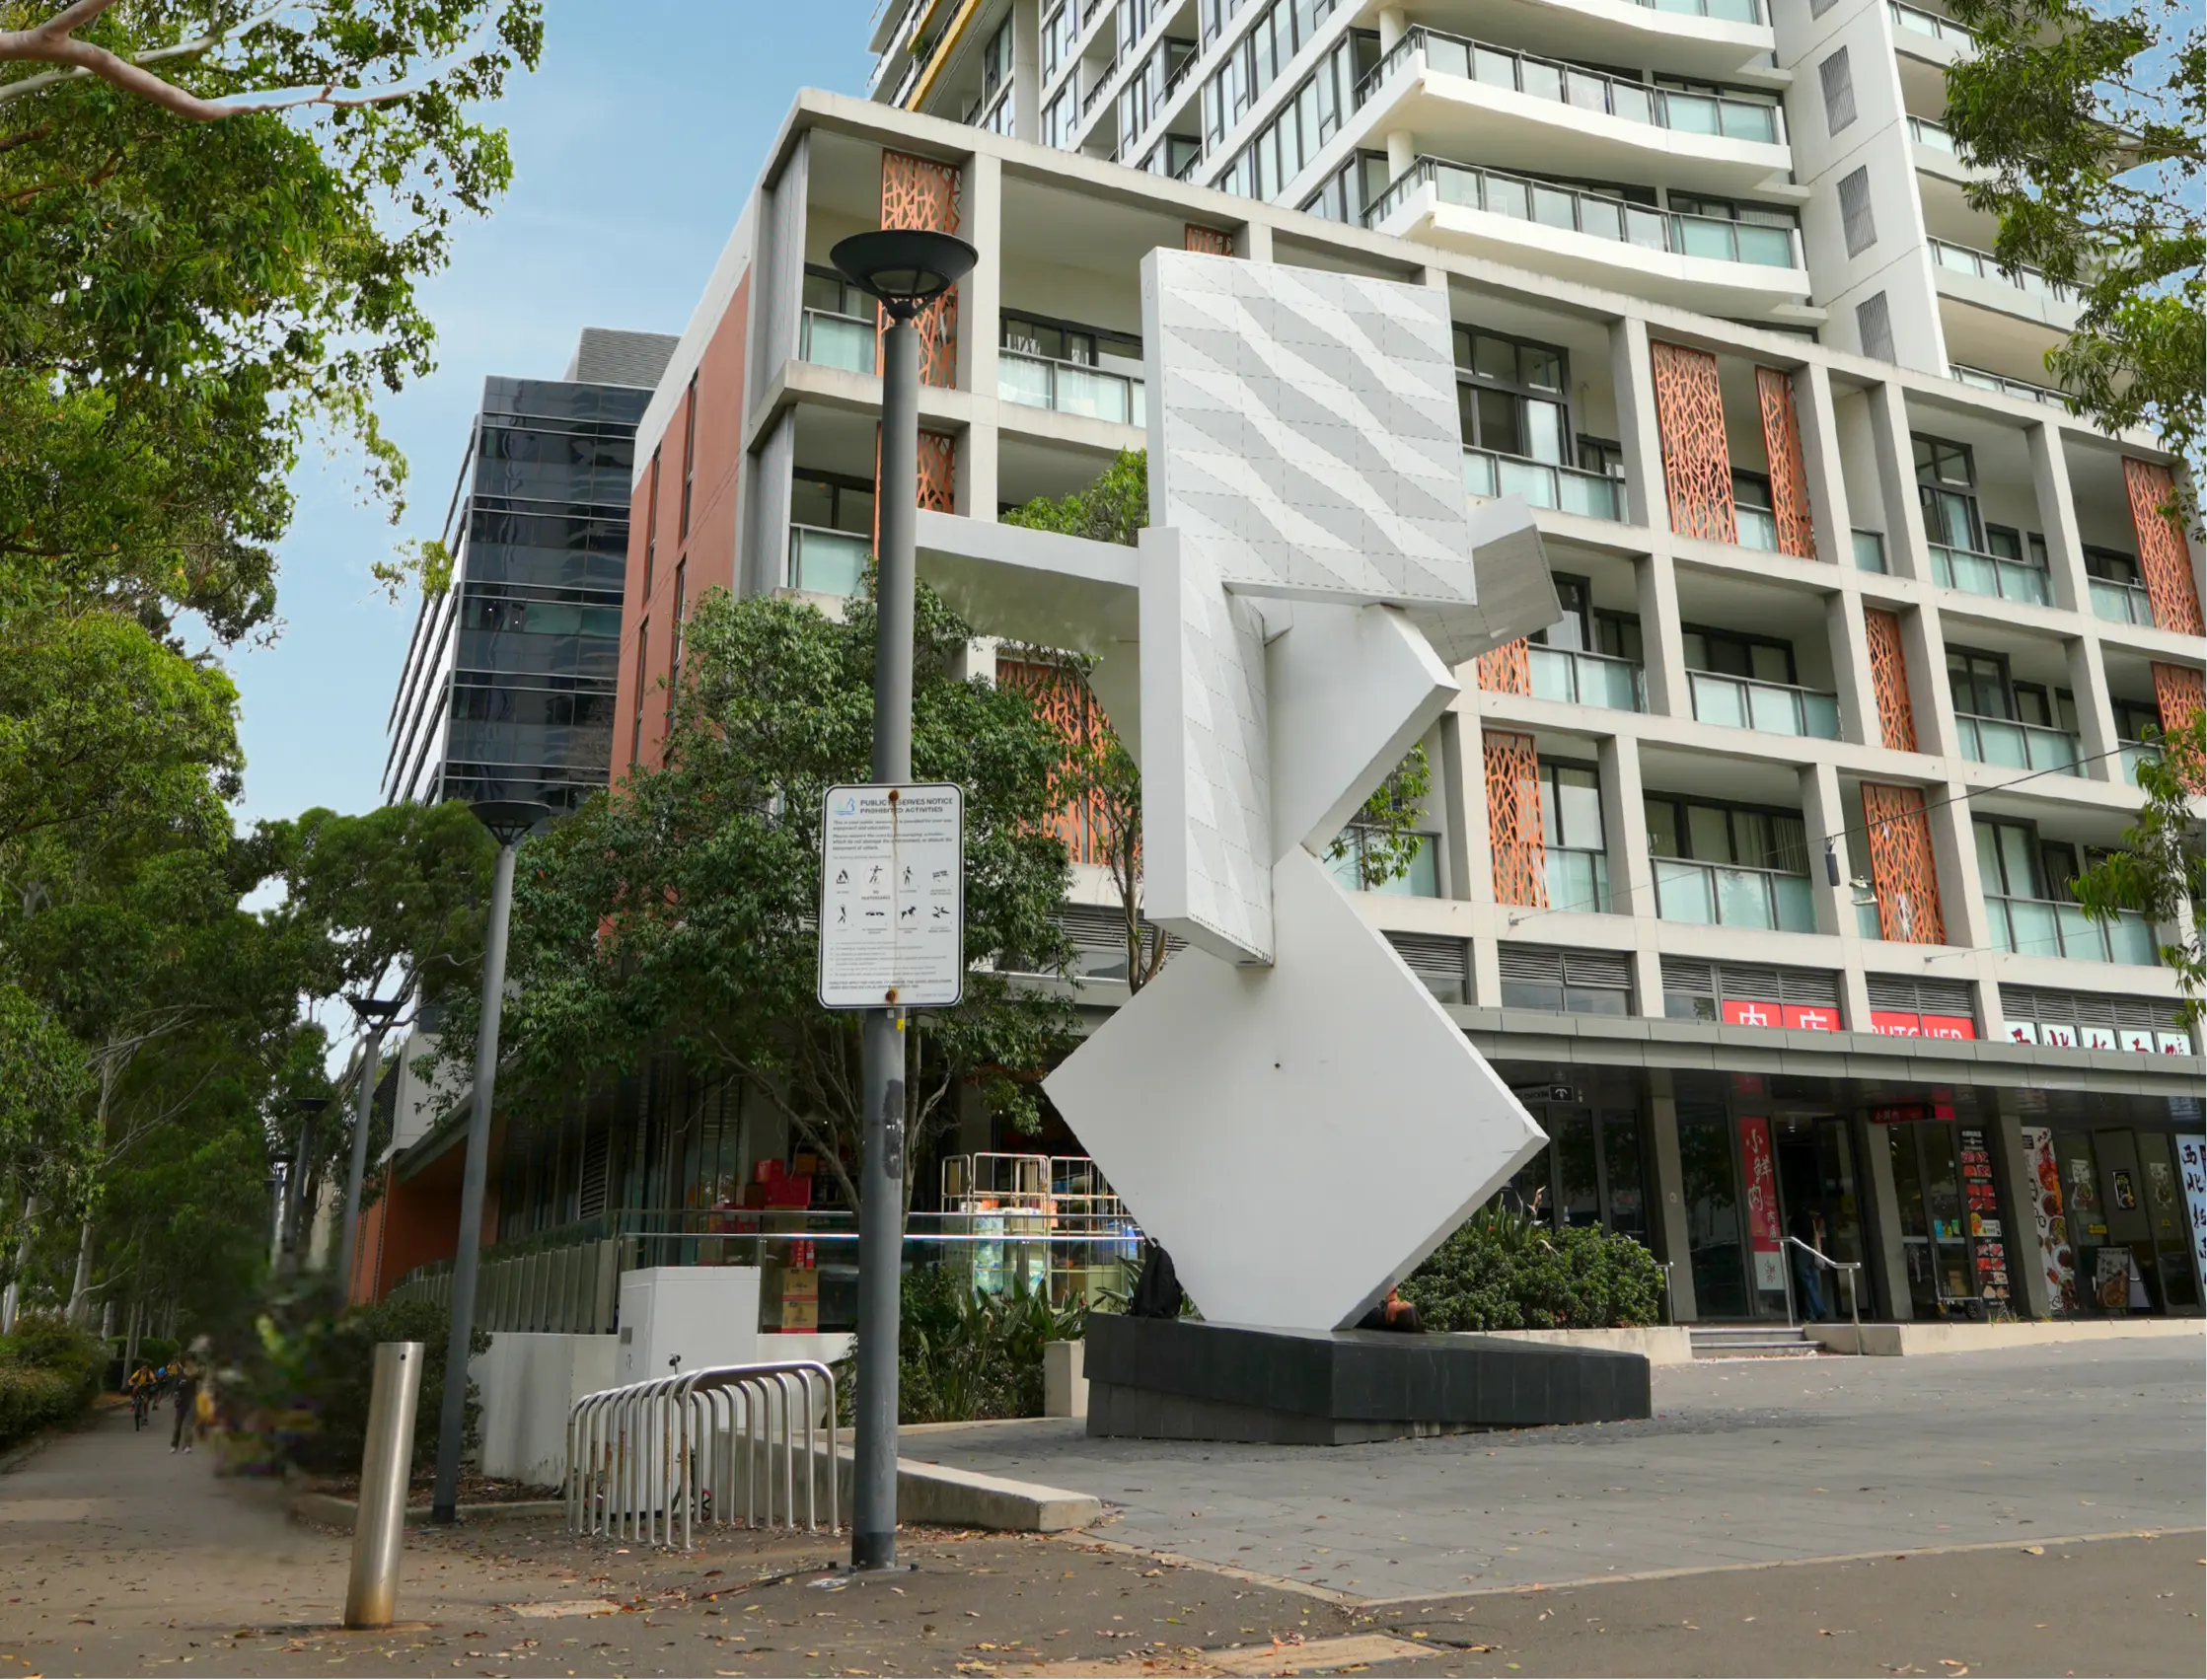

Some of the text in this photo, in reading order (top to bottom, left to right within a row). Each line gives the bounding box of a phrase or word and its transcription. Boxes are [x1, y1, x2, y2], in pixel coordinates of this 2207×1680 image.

[860, 798, 887, 807] PUBLIC
[888, 797, 925, 806] RSERVES
[1871, 1023, 1962, 1040] UTCHER
